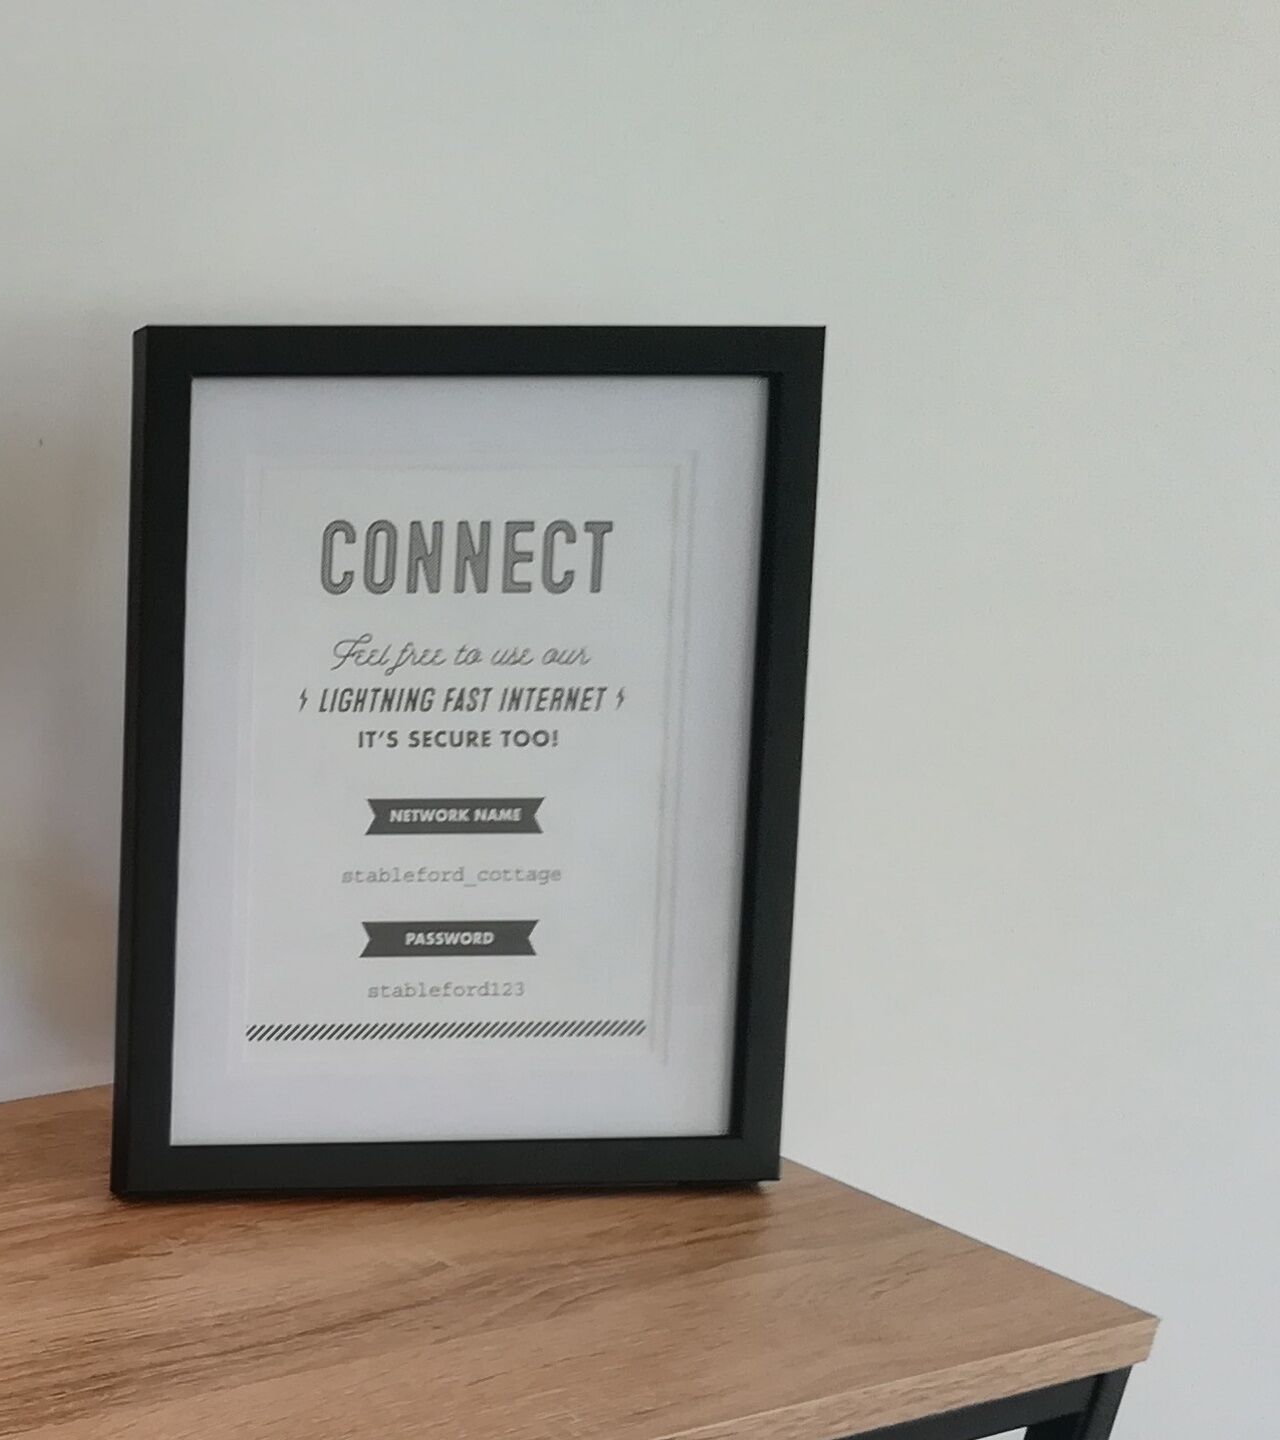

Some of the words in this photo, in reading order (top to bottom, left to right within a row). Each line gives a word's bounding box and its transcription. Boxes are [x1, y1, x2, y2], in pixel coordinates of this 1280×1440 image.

[320, 519, 614, 596] CONNECT
[330, 633, 389, 671] Feel
[384, 642, 447, 676] free
[453, 644, 484, 666] to
[491, 647, 534, 666] use
[540, 646, 593, 666] our
[318, 687, 436, 713] LIGHTNING
[441, 686, 494, 713] FAST
[497, 685, 608, 712] INTERNET
[357, 730, 399, 748] IT'S
[408, 729, 491, 748] SECURE
[500, 729, 559, 748] TOO!
[389, 808, 470, 823] NETWORK
[473, 807, 522, 822] NAME
[341, 866, 562, 887] stableford_cottage
[405, 931, 495, 946] PASSWORD
[367, 981, 526, 999] stableford123
